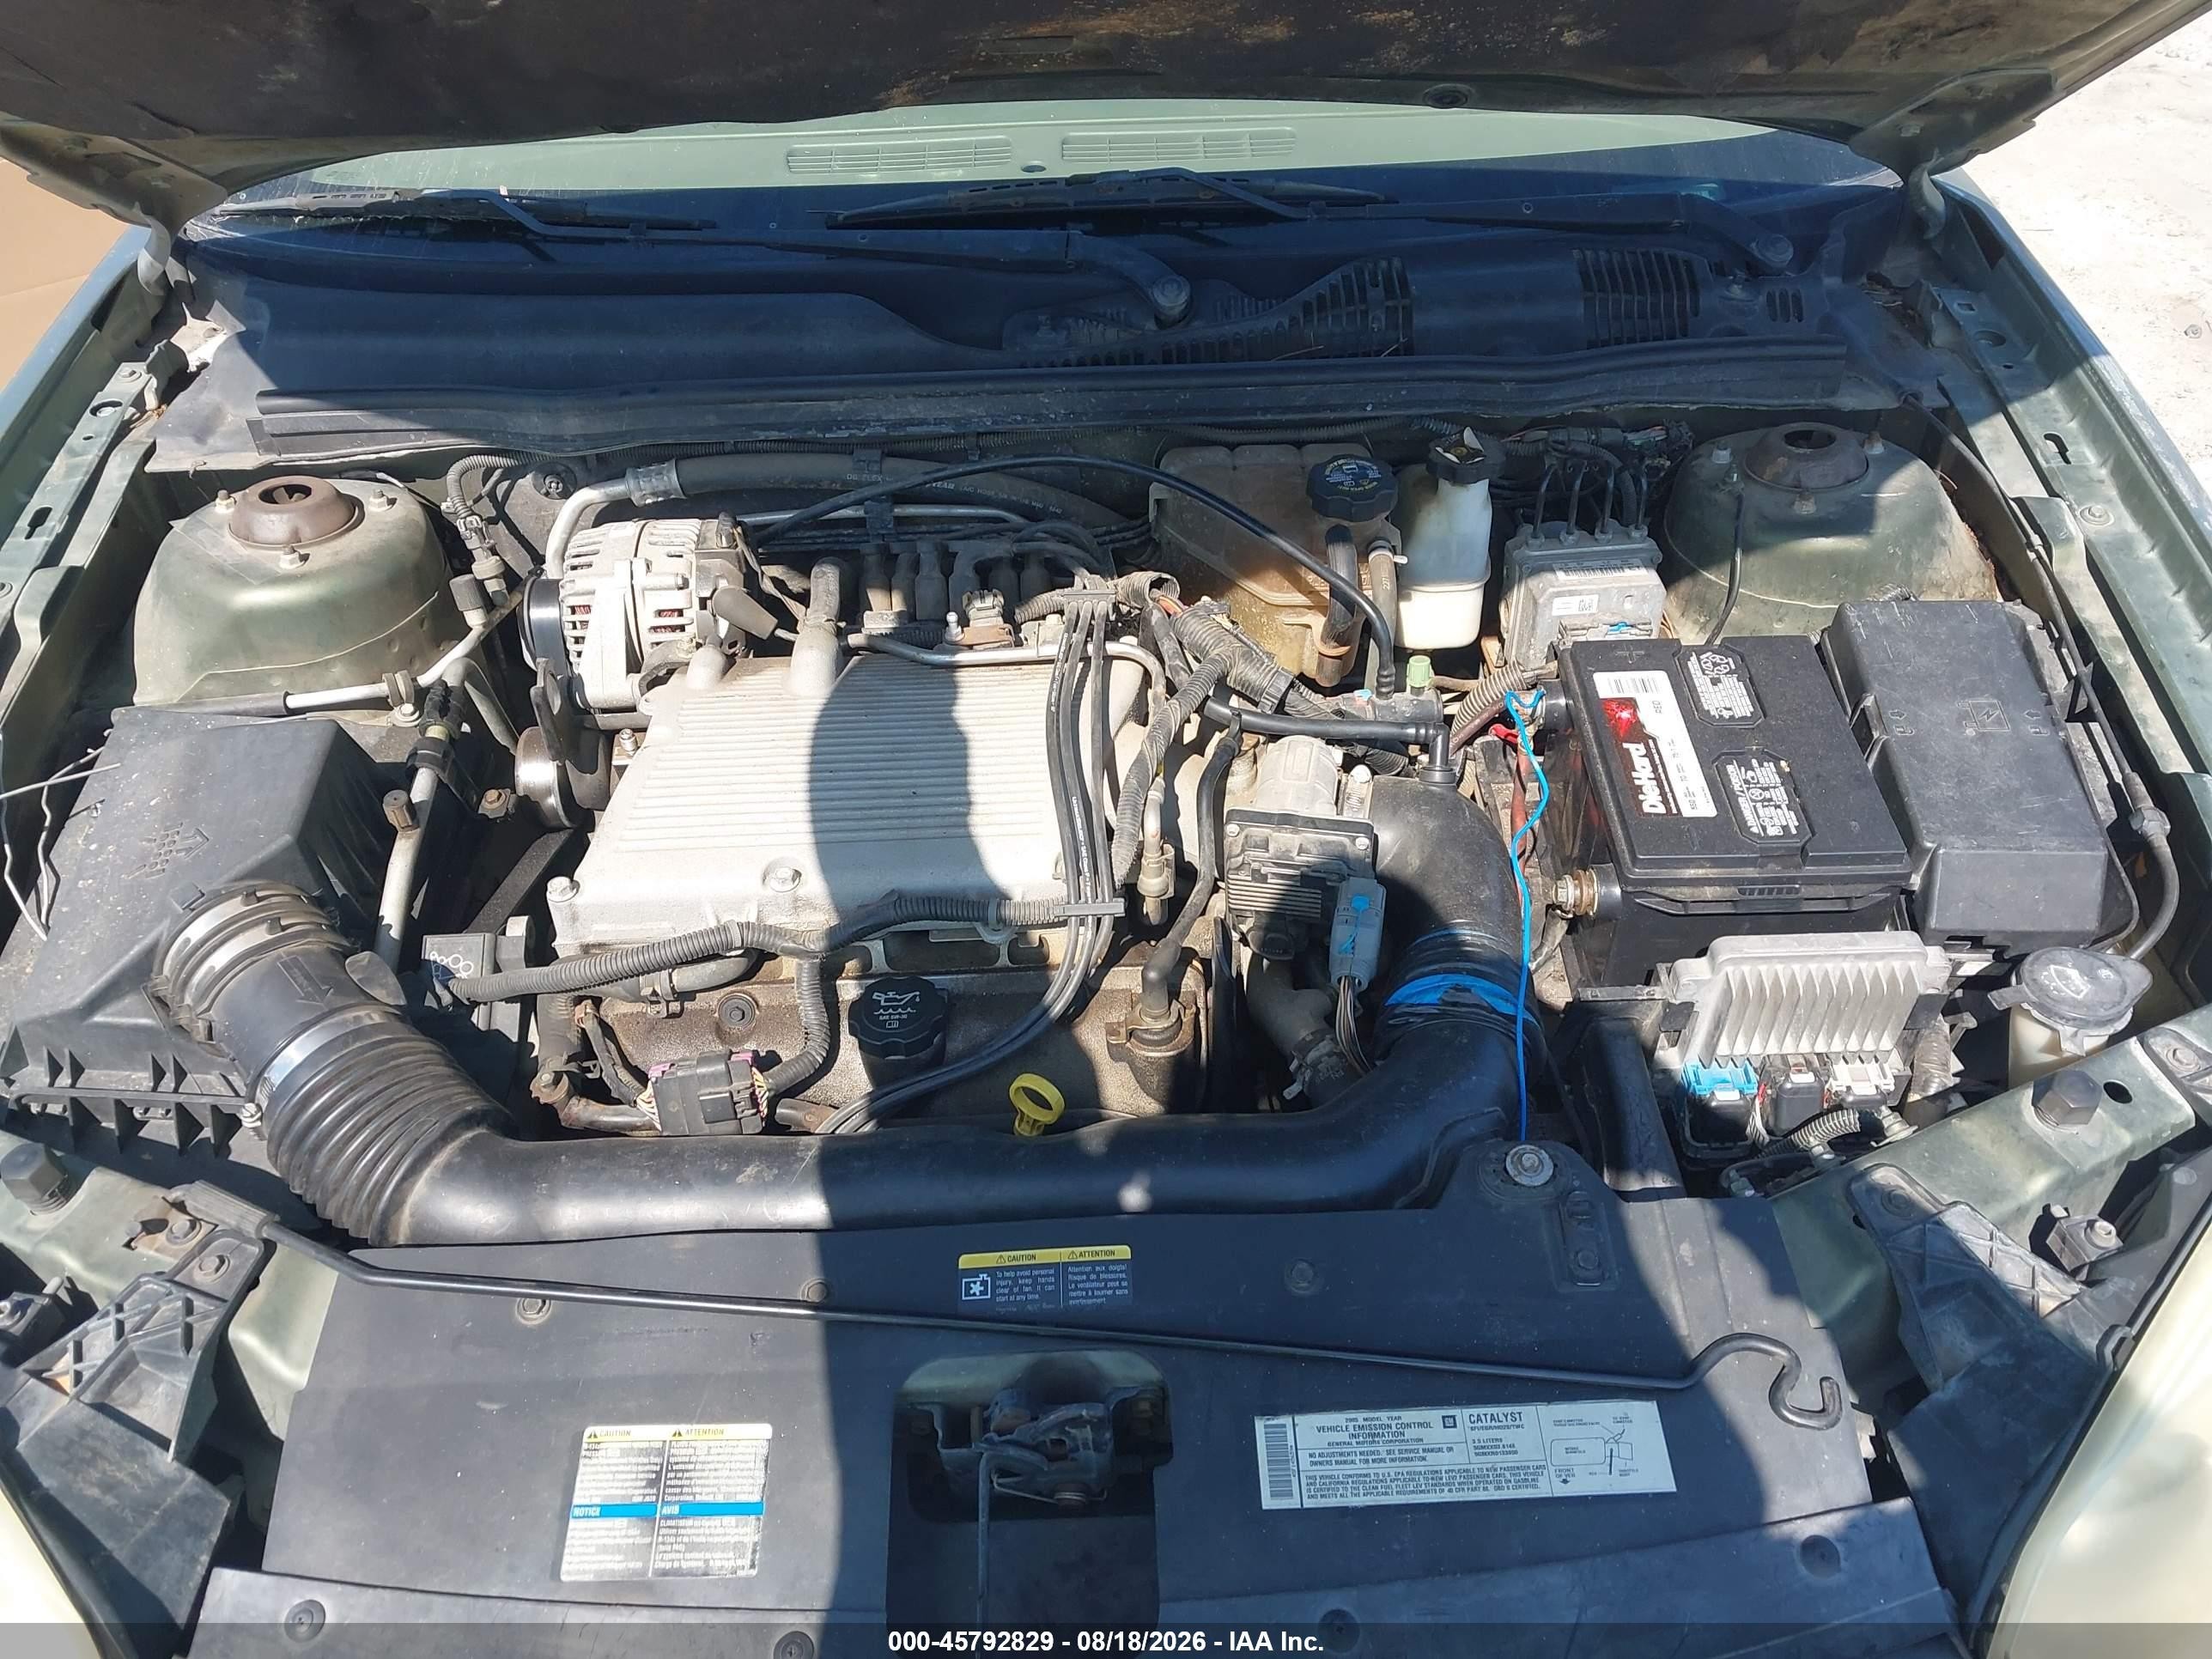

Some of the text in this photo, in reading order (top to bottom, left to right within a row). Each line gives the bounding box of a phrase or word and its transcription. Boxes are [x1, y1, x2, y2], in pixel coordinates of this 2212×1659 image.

[1622, 742, 1667, 814] DieHard
[1007, 1254, 1036, 1262] CAUTION
[1468, 1412, 1522, 1424] CATALYST
[1316, 1425, 1350, 1433] VEHICLE
[1353, 1423, 1392, 1432] EMISSION
[1348, 1431, 1406, 1440] INFORMATION
[573, 1506, 601, 1517] NOTICE
[662, 1504, 680, 1516] AVIS
